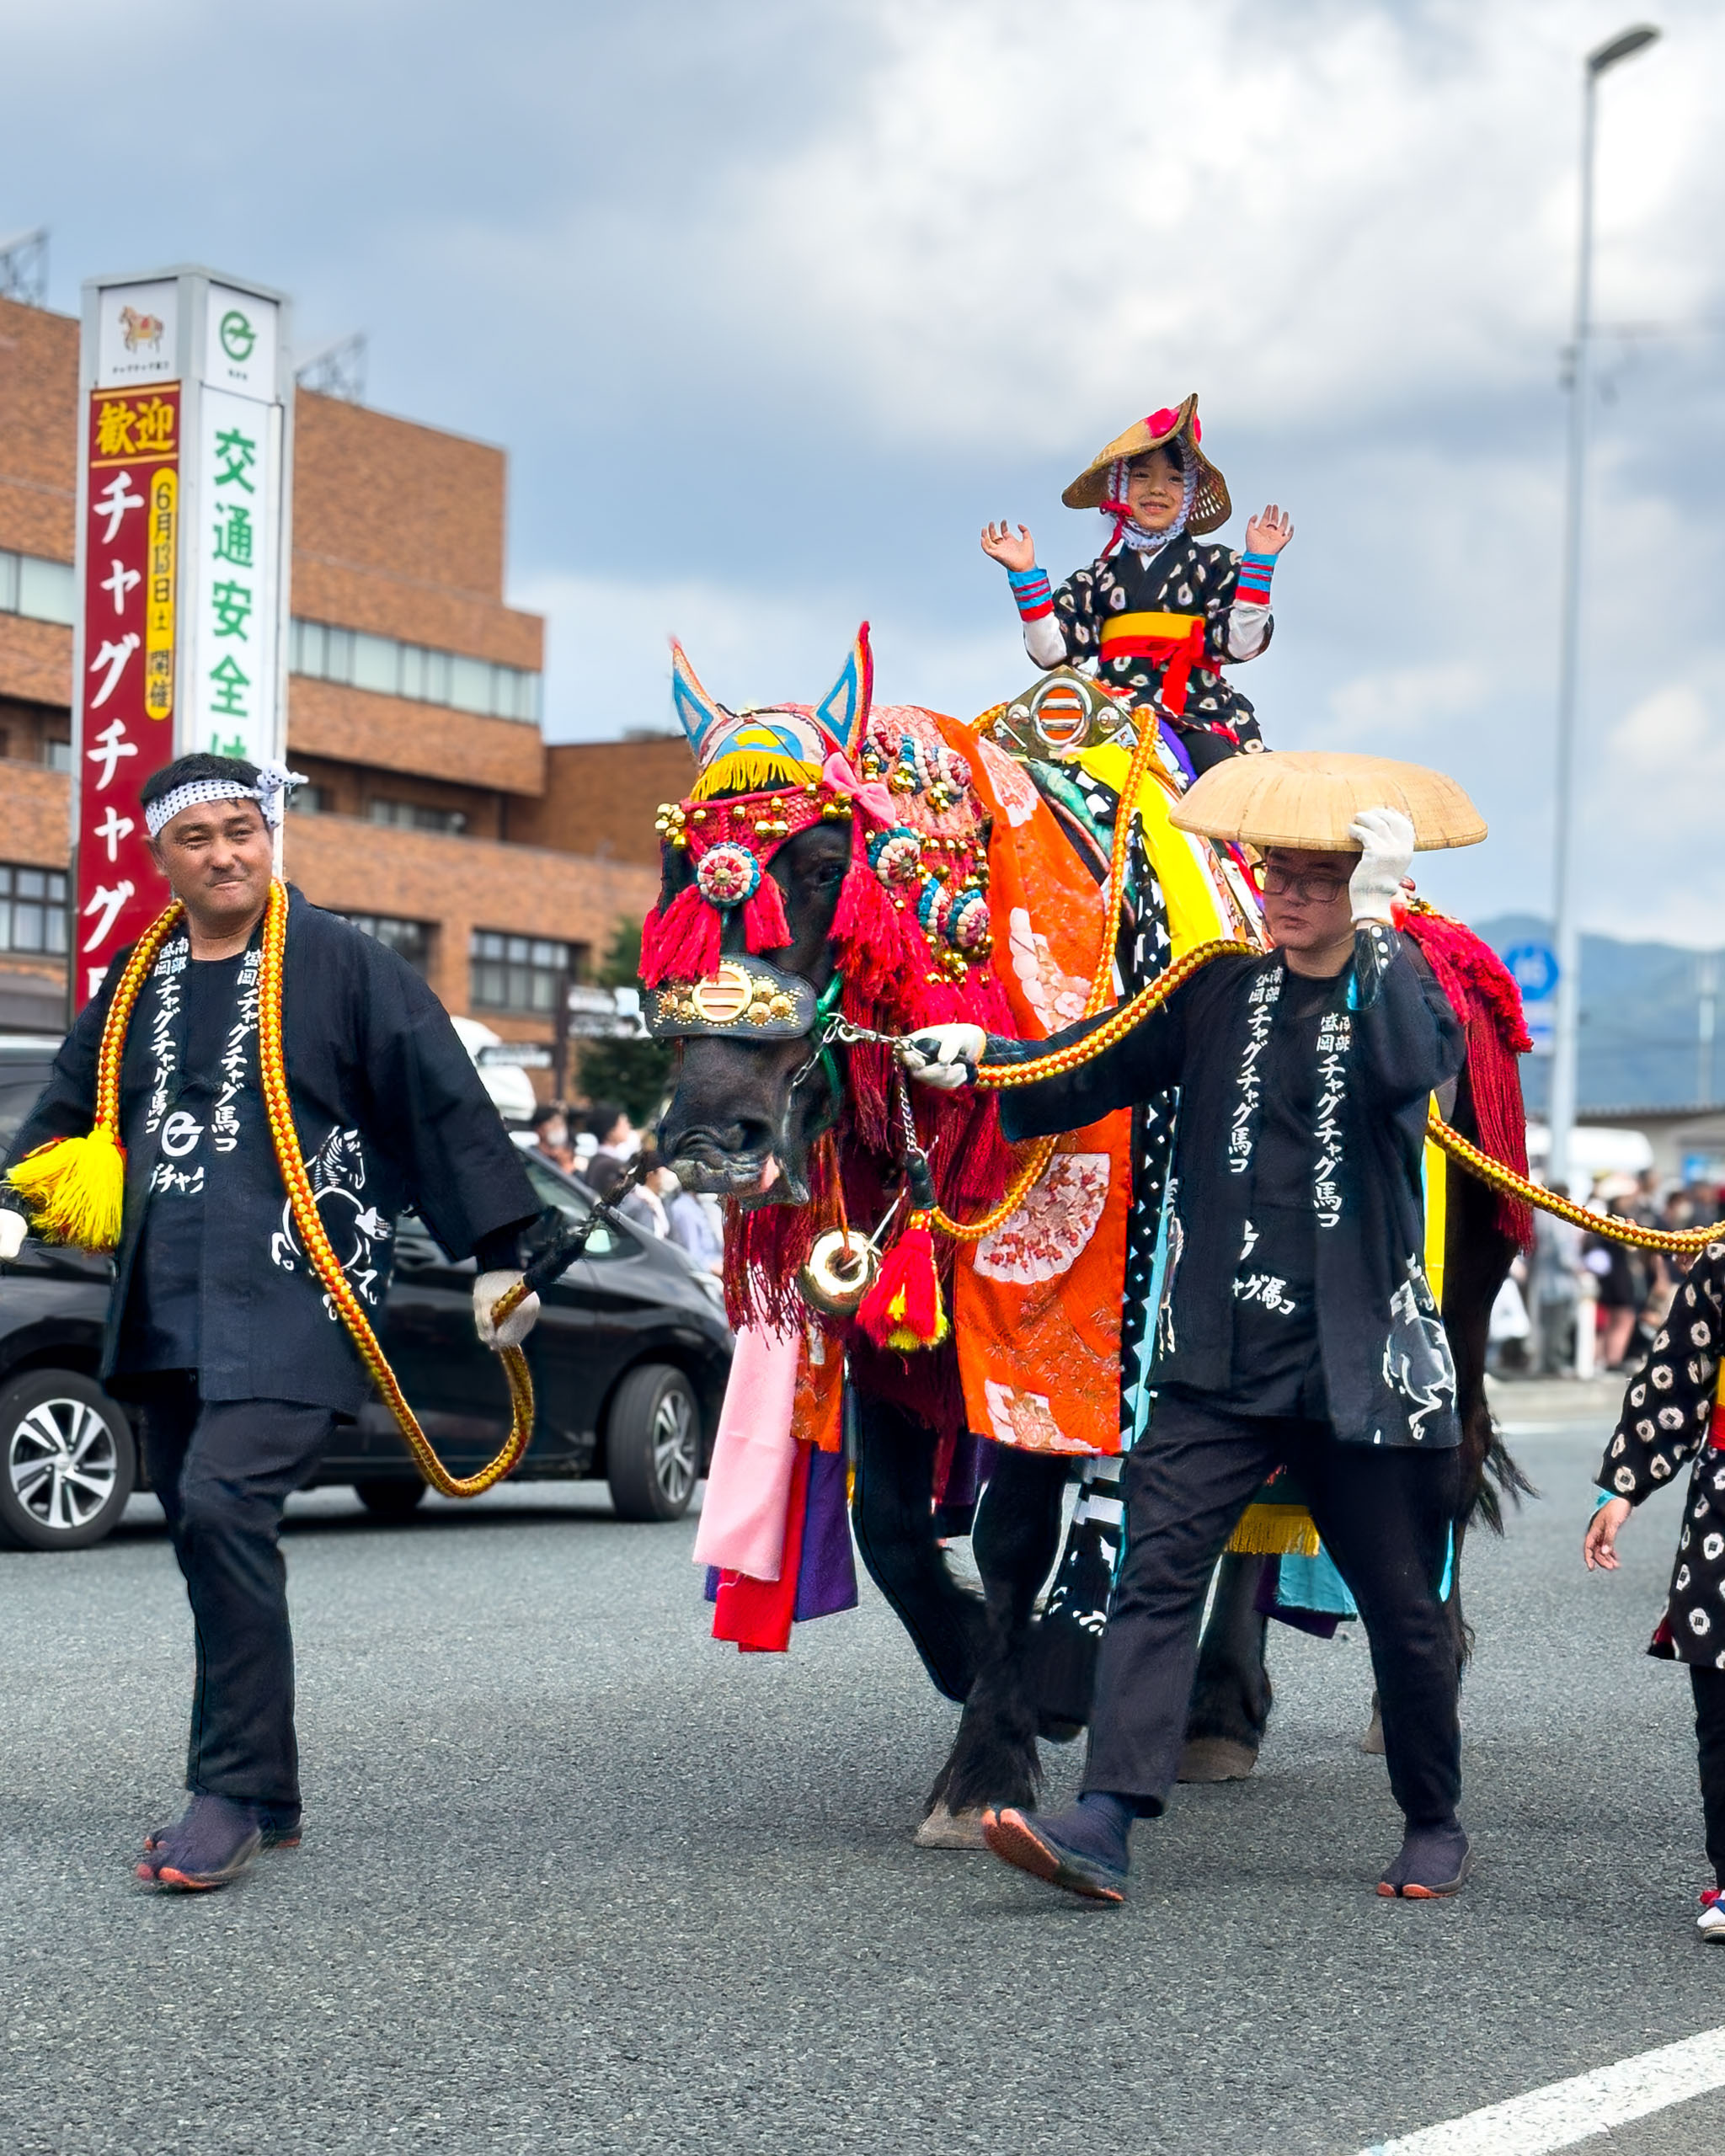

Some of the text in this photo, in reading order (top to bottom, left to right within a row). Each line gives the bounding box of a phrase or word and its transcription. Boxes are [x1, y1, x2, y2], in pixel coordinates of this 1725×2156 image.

[1228, 1004, 1273, 1172] チャグチャグ馬コ
[1313, 1054, 1346, 1227] チャグチャグ馬コ
